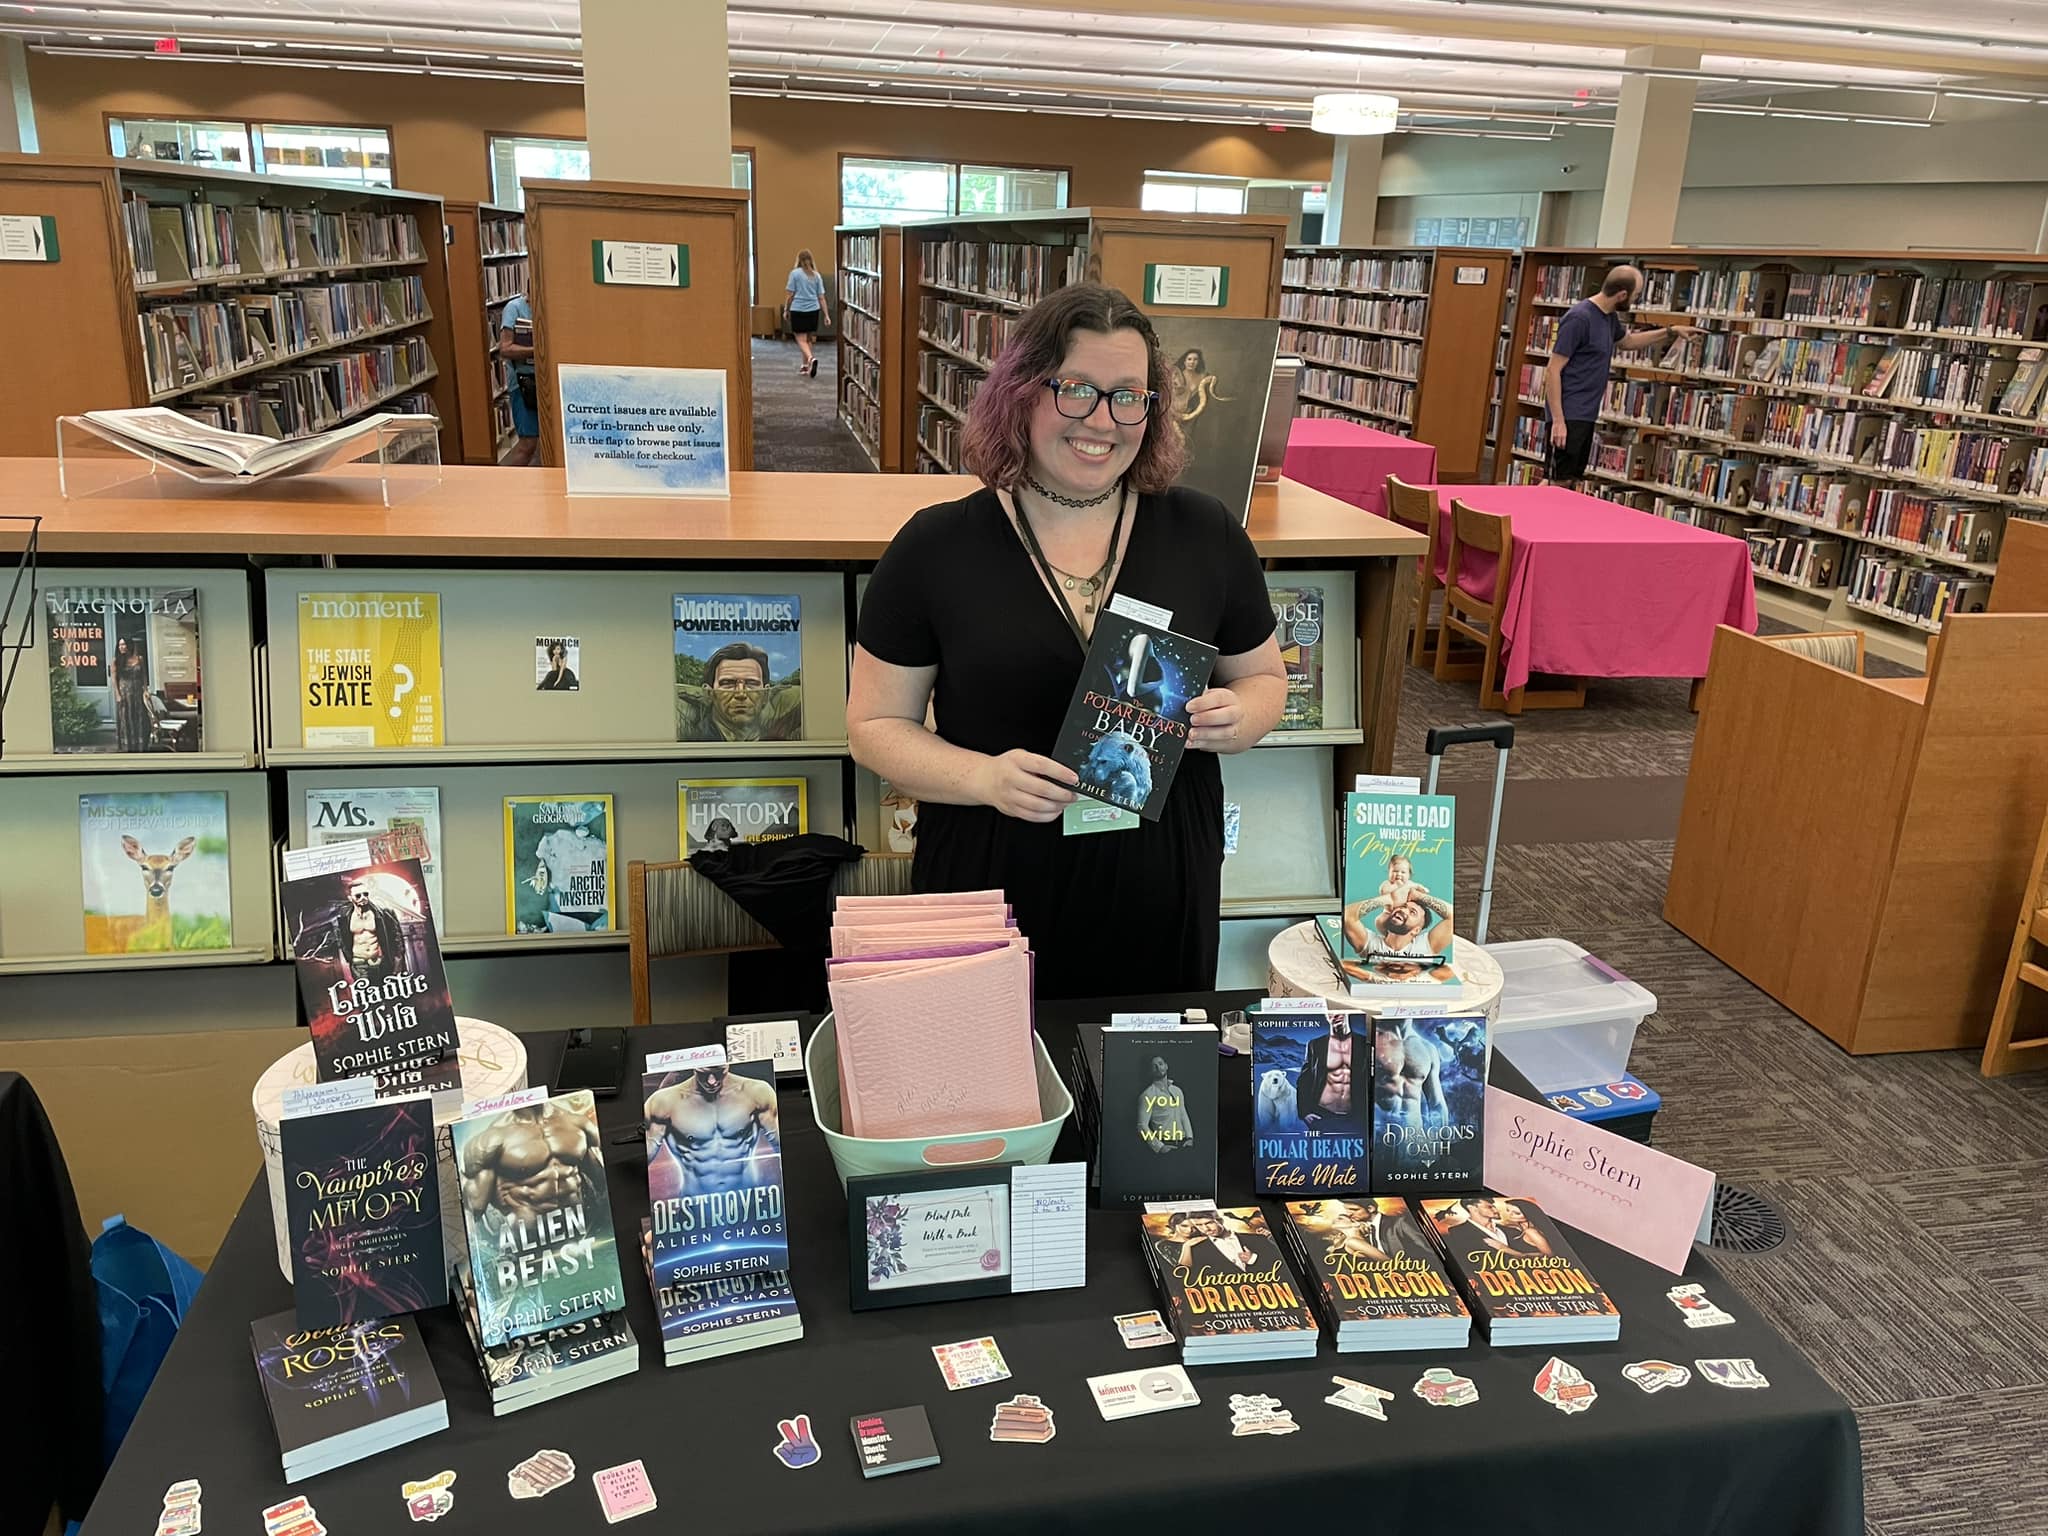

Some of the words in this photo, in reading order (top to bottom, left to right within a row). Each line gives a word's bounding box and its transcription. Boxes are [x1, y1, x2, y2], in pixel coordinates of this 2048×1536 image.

[567, 404, 611, 414] Current
[614, 404, 647, 416] issues
[649, 408, 666, 416] are
[669, 406, 717, 418] available
[582, 420, 599, 430] for
[601, 420, 654, 432] in-branch
[657, 424, 676, 432] use
[678, 423, 705, 435] only.
[569, 436, 586, 445] Lift
[588, 437, 602, 445] the
[605, 437, 623, 447] flap
[625, 438, 634, 446] to
[636, 438, 670, 447] browse
[672, 440, 691, 449] past
[693, 440, 720, 448] issues
[594, 451, 635, 460] available
[636, 451, 650, 460] for
[652, 451, 697, 461] checkout.
[51, 598, 189, 615] MAGNOLIA
[311, 596, 424, 618] moment
[679, 600, 743, 620] Mother
[744, 600, 792, 620] Jones
[1272, 603, 1319, 622] OUSE
[52, 627, 103, 640] SUMMER
[673, 619, 731, 632] POWER
[731, 619, 800, 632] HUNGRY
[65, 641, 89, 654] YOU
[307, 648, 331, 664] THE
[335, 648, 371, 664] STATE
[60, 655, 98, 667] SAVOR
[321, 665, 372, 681] JEWISH
[309, 682, 373, 707] STATE
[1083, 691, 1133, 720] POLAR
[1137, 711, 1186, 738] BEAR'S
[1092, 710, 1164, 752] BABY
[87, 805, 163, 818] MISSOURI
[1111, 793, 1145, 811] STERN
[312, 800, 375, 828] Ms.
[691, 802, 795, 825] HISTORY
[1356, 802, 1413, 827] SINGLE
[1417, 806, 1450, 829] DAD
[1380, 827, 1400, 841] WHO
[1401, 829, 1426, 842] STOLE
[1352, 832, 1392, 866] My
[591, 860, 605, 875] AN
[570, 876, 605, 890] ARCTIC
[559, 890, 605, 907] MYSTERY
[328, 971, 428, 1017] Chaotic
[346, 1003, 418, 1042] Wild
[1258, 1020, 1290, 1028] SOPHIE
[1293, 1020, 1320, 1028] STERN
[333, 1046, 393, 1074] SOPHIE
[397, 1032, 451, 1057] STERN
[472, 1093, 534, 1113] Standalone
[1144, 1094, 1180, 1113] you
[1140, 1121, 1184, 1142] wish
[1304, 1130, 1321, 1138] THE
[1383, 1123, 1475, 1146] DRAGON'S
[1258, 1138, 1309, 1160] POLAR
[1312, 1138, 1364, 1160] BEAR'S
[1406, 1141, 1451, 1156] OATH
[1508, 1116, 1576, 1162] Sophie
[1582, 1146, 1642, 1190] Stern
[296, 1152, 429, 1200] Vampire's
[345, 1158, 367, 1172] THE
[1265, 1162, 1306, 1188] Fake
[1312, 1164, 1358, 1188] Mate
[1387, 1172, 1429, 1181] SOPHIE
[1434, 1172, 1470, 1180] STERN
[1122, 1194, 1161, 1202] SOPHIE
[308, 1188, 424, 1233] MELODY
[653, 1185, 782, 1236] DESTROYED
[924, 1208, 949, 1224] Blind
[950, 1206, 972, 1220] Date
[500, 1203, 586, 1255] ALIEN
[656, 1233, 712, 1250] ALIEN
[723, 1222, 783, 1240] CHAOS
[922, 1228, 946, 1242] With
[946, 1232, 954, 1240] a
[956, 1225, 979, 1238] Book
[321, 1261, 373, 1278] SOPHIE
[378, 1252, 419, 1267] STERN
[497, 1236, 596, 1291] BEAST
[673, 1262, 722, 1280] SOPHIE
[725, 1255, 770, 1272] STERN
[1324, 1250, 1431, 1278] Naughty
[1468, 1249, 1571, 1274] Monster
[1173, 1260, 1283, 1288] Untamed
[1478, 1268, 1595, 1297] DRAGON
[658, 1270, 788, 1310] DESTROYED
[1335, 1272, 1450, 1300] DRAGON
[664, 1301, 720, 1319] ALIEN
[730, 1288, 792, 1304] CHAOS
[1184, 1281, 1300, 1314] DRAGON
[1506, 1300, 1554, 1313] SOPHIE
[1559, 1300, 1600, 1312] STERN
[489, 1304, 554, 1338] SOPHIE
[560, 1285, 617, 1317] STERN
[1357, 1304, 1406, 1316] SOPHIE
[1412, 1302, 1452, 1314] STERN
[682, 1317, 733, 1335] SOPHIE
[735, 1308, 782, 1324] STERN
[1204, 1317, 1252, 1331] SOPHIE
[1261, 1315, 1300, 1328] STERN
[282, 1325, 405, 1379] ROSES
[499, 1352, 564, 1381] SOPHIE
[569, 1333, 628, 1360] STERN
[304, 1386, 358, 1409] SOPHIE
[361, 1372, 406, 1392] STERN
[861, 1434, 893, 1446] Monsters.
